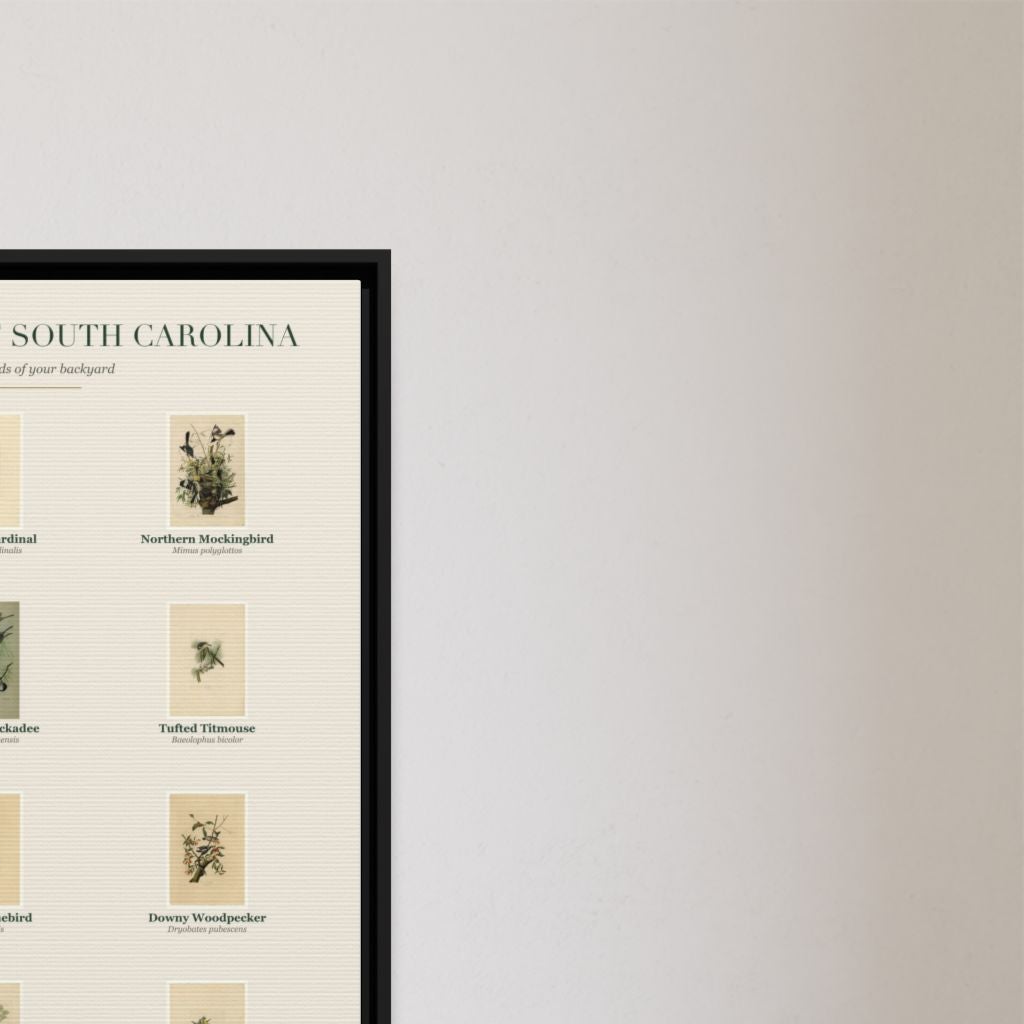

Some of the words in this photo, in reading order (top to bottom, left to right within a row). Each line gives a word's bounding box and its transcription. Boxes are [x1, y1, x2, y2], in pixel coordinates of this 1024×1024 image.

[11, 323, 123, 347] SOUTH
[133, 323, 300, 347] CAROLINA
[14, 363, 28, 377] of
[29, 366, 57, 377] your
[60, 363, 116, 377] backyard
[141, 534, 195, 544] Northern
[199, 534, 274, 546] Mockingbird
[200, 547, 243, 556] polyglottos
[159, 723, 198, 733] Tufted
[200, 723, 256, 733] Titmouse
[172, 736, 215, 745] Baeolophus
[217, 736, 243, 744] bicolor
[149, 913, 189, 924] Downy
[192, 913, 267, 924] Woodpecker
[168, 926, 207, 934] Dryobates
[208, 926, 247, 934] pubescens
